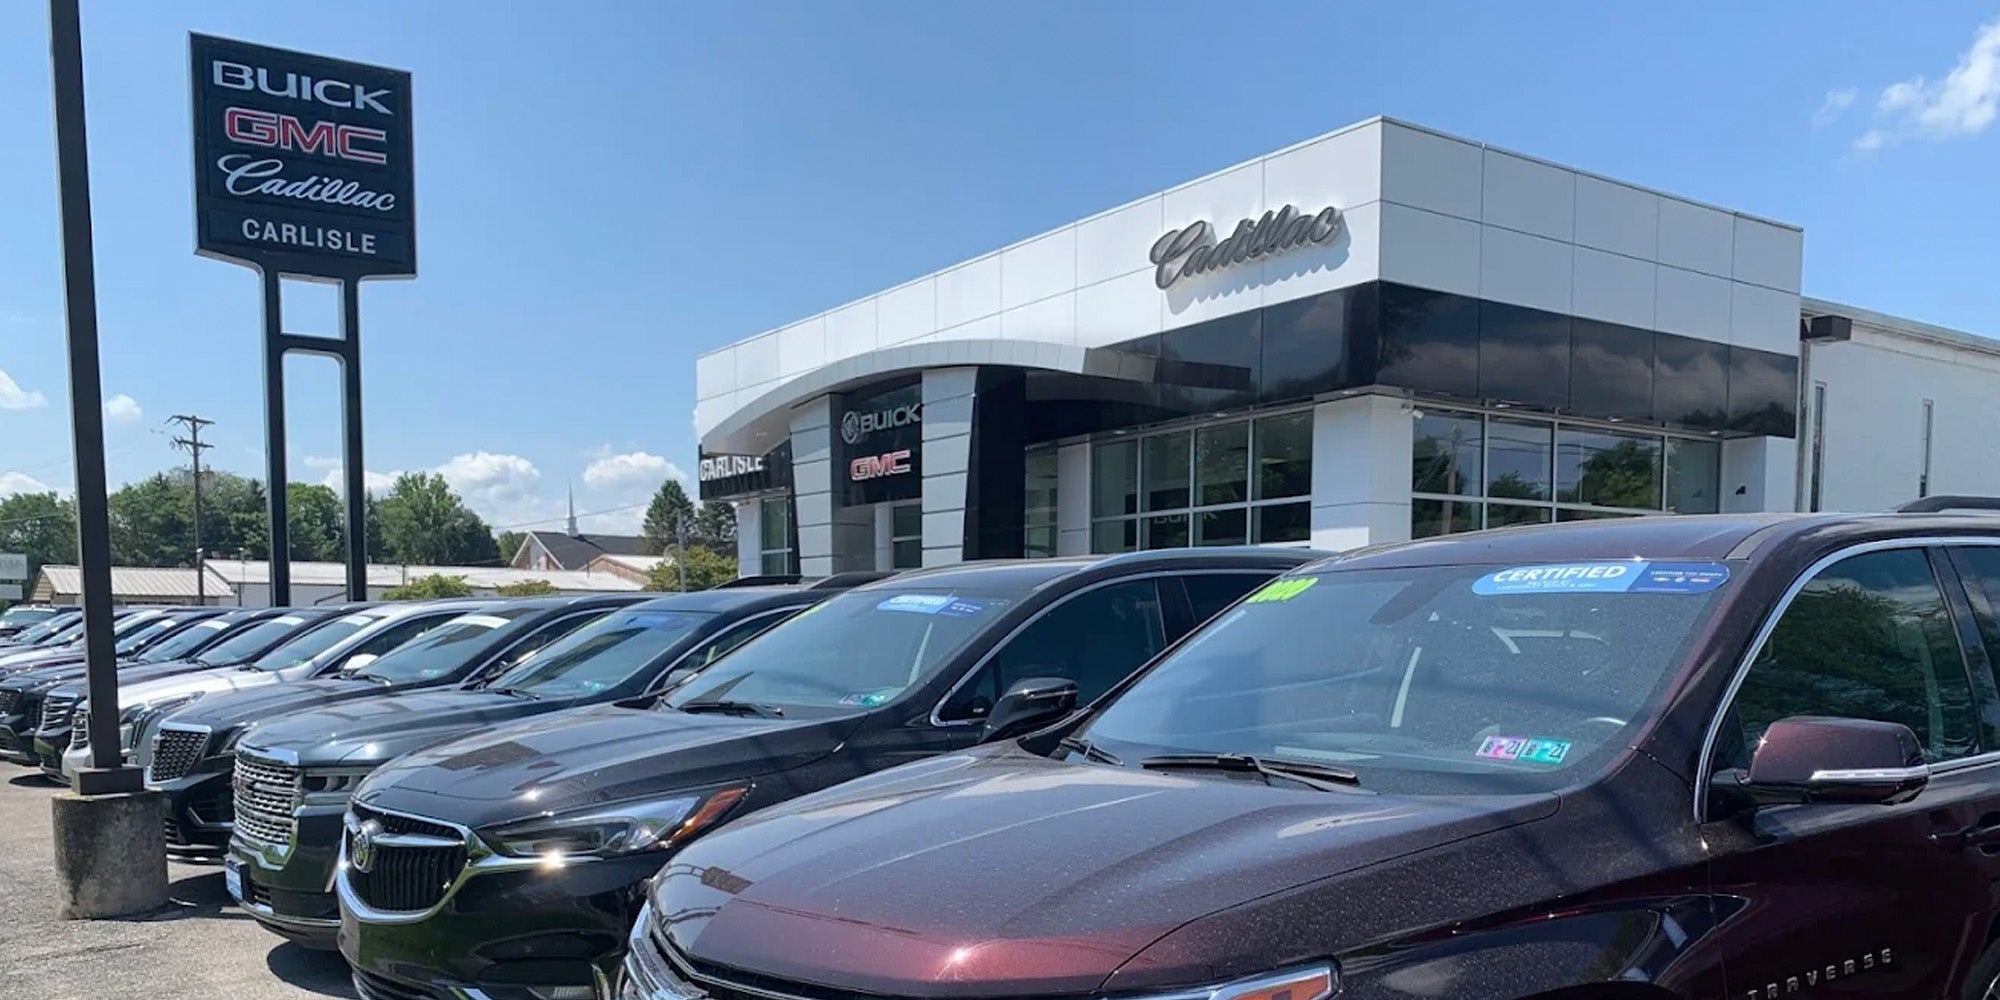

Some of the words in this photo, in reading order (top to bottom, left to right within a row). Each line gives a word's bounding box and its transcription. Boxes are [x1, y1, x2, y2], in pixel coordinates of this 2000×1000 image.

[212, 59, 394, 116] BUICK
[224, 106, 388, 165] GMC
[216, 154, 396, 212] Cadillac
[241, 218, 377, 255] CARLISLE
[1149, 203, 1344, 290] Cadillac
[859, 401, 922, 434] BUICK
[700, 455, 765, 482] CARLISLE
[850, 449, 912, 482] GMC
[1493, 565, 1628, 582] CERTIFIED
[1747, 947, 1892, 1000] TRAVERSE
